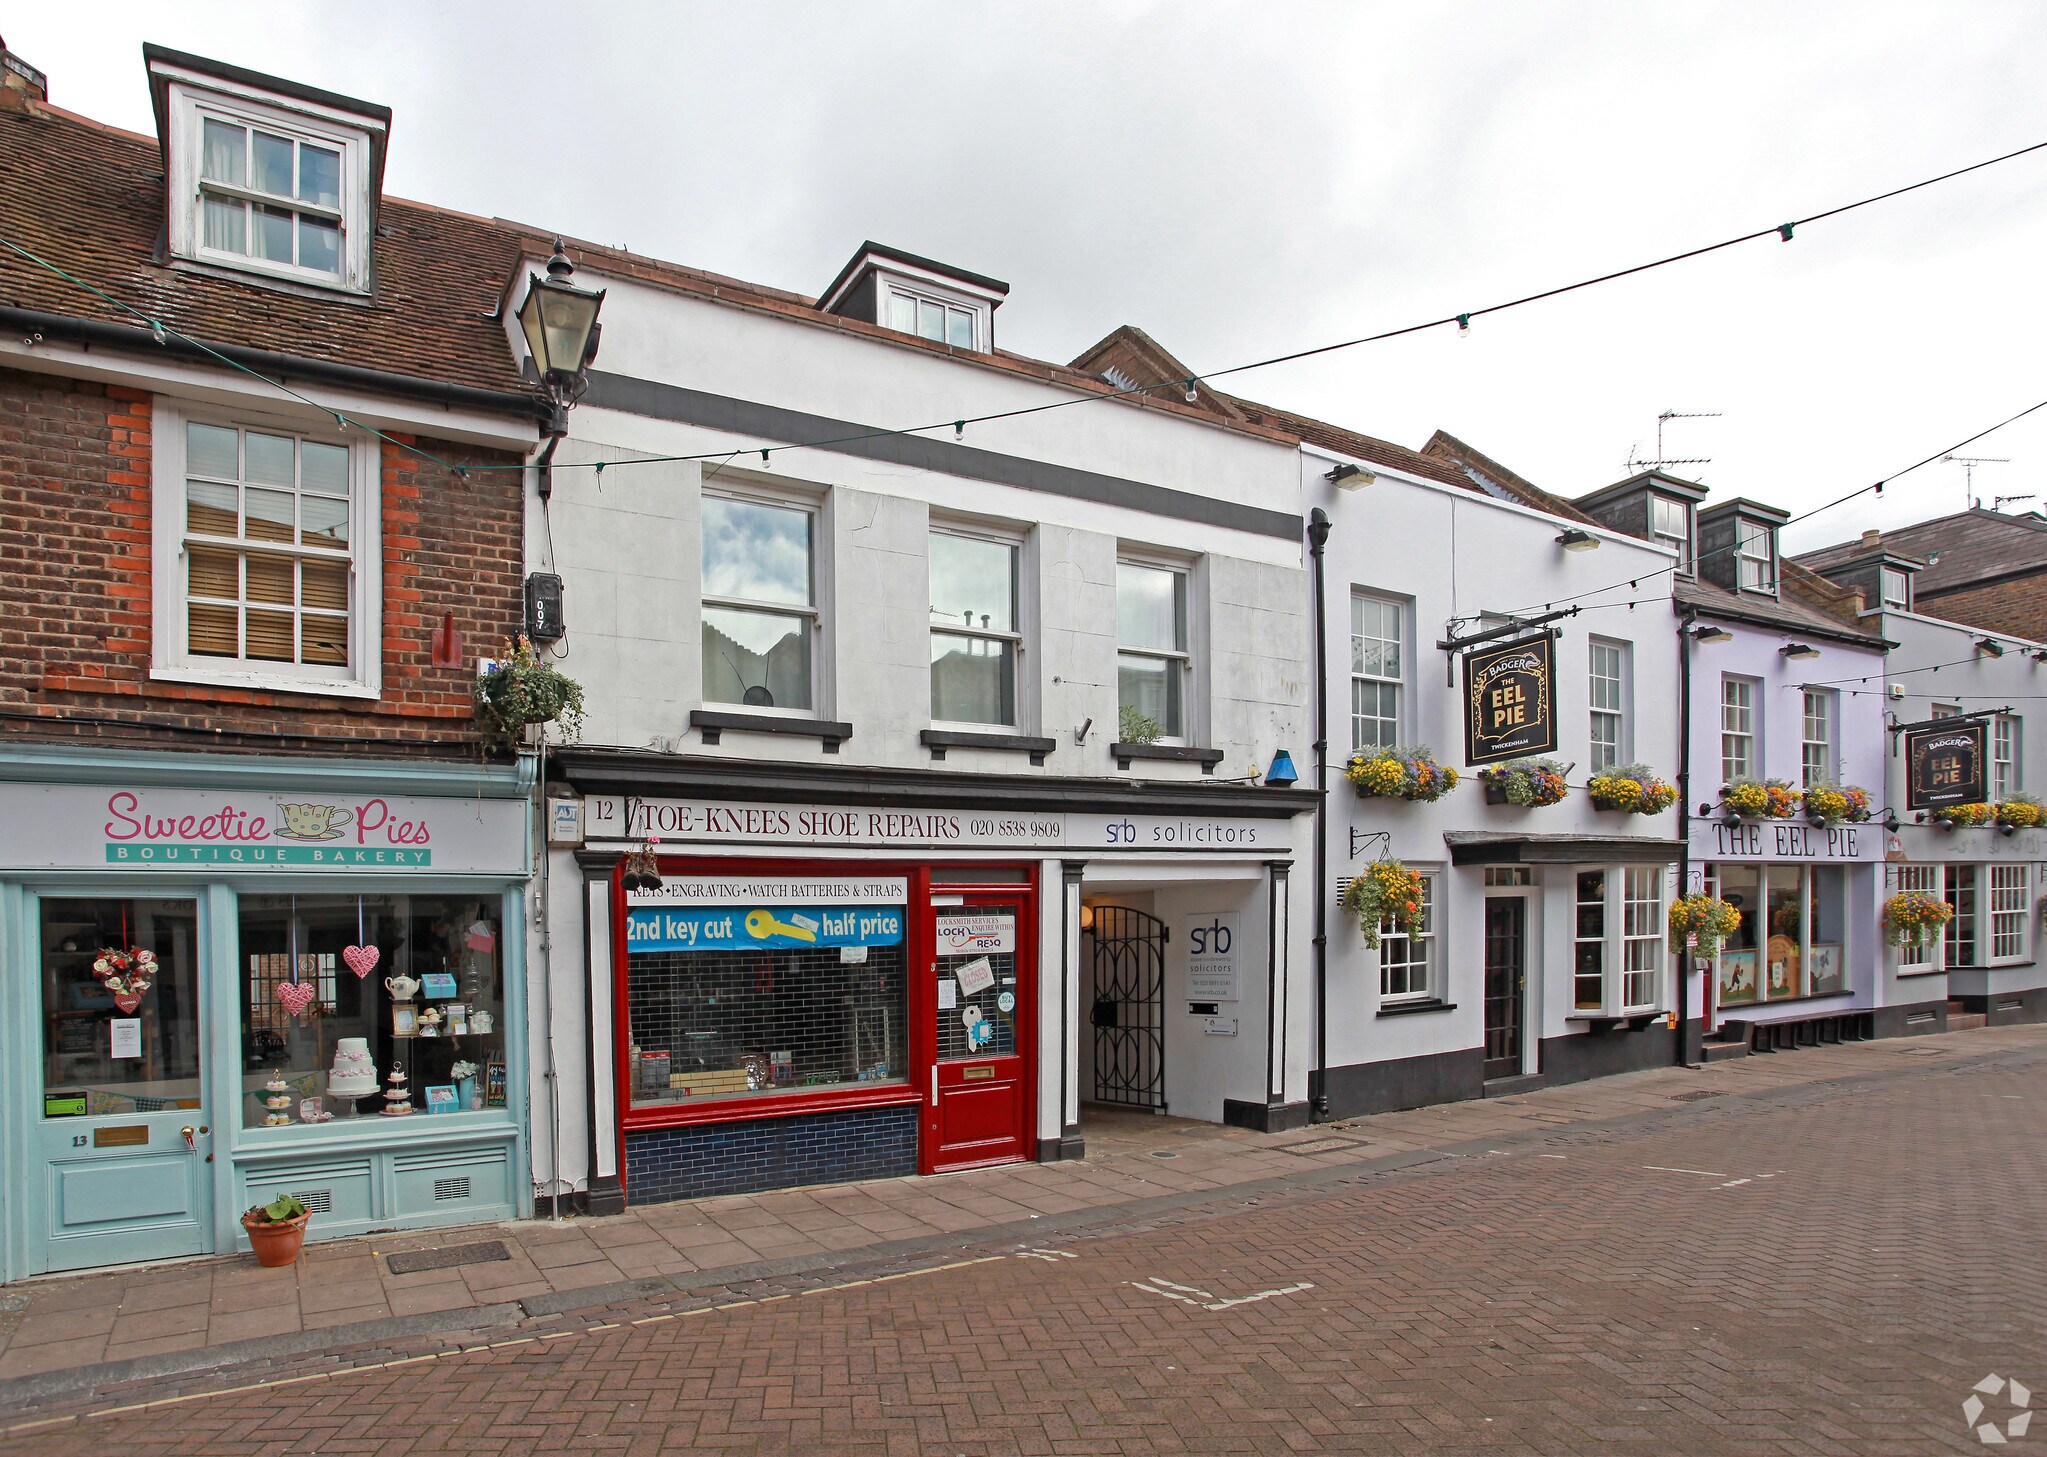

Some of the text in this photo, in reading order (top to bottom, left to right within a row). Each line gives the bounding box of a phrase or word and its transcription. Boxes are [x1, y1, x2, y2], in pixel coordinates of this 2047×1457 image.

[536, 600, 544, 630] 007
[1489, 658, 1527, 677] BADGER
[1501, 677, 1515, 686] THE
[1492, 685, 1526, 708] EEL
[1494, 705, 1526, 728] PIE
[1491, 738, 1529, 751] TWICKENHAM
[1928, 738, 1962, 751] BADGER
[1931, 756, 1961, 770] EEL
[1933, 769, 1960, 785] PIE
[1929, 793, 1963, 801] TWICKENHAM
[557, 806, 577, 819] ADT
[596, 800, 613, 820] 12
[104, 791, 431, 845] Sweetie Pies
[641, 804, 1060, 839] TOE-KNEES SHOE REPAIRS 020 8538 9809
[1153, 822, 1256, 843] solicitors
[1712, 823, 1859, 857] THE EEL PIE
[117, 847, 425, 863] BOUTIQUE BAKERY
[671, 884, 740, 898] ENGRAVING
[748, 884, 787, 897] WATCH
[791, 884, 850, 897] BATTERIES
[852, 884, 860, 897] &
[863, 884, 902, 897] STRAPS
[627, 912, 898, 946] 2nd key cut half price
[937, 917, 999, 926] LOCKSMITH SERVICES
[971, 924, 995, 932] ENQUIRE
[937, 927, 965, 937] LOCK
[977, 939, 1001, 948] RESQ
[1190, 963, 1232, 973] solicitors
[964, 967, 988, 987] CLOSED
[72, 1134, 88, 1147] 13
